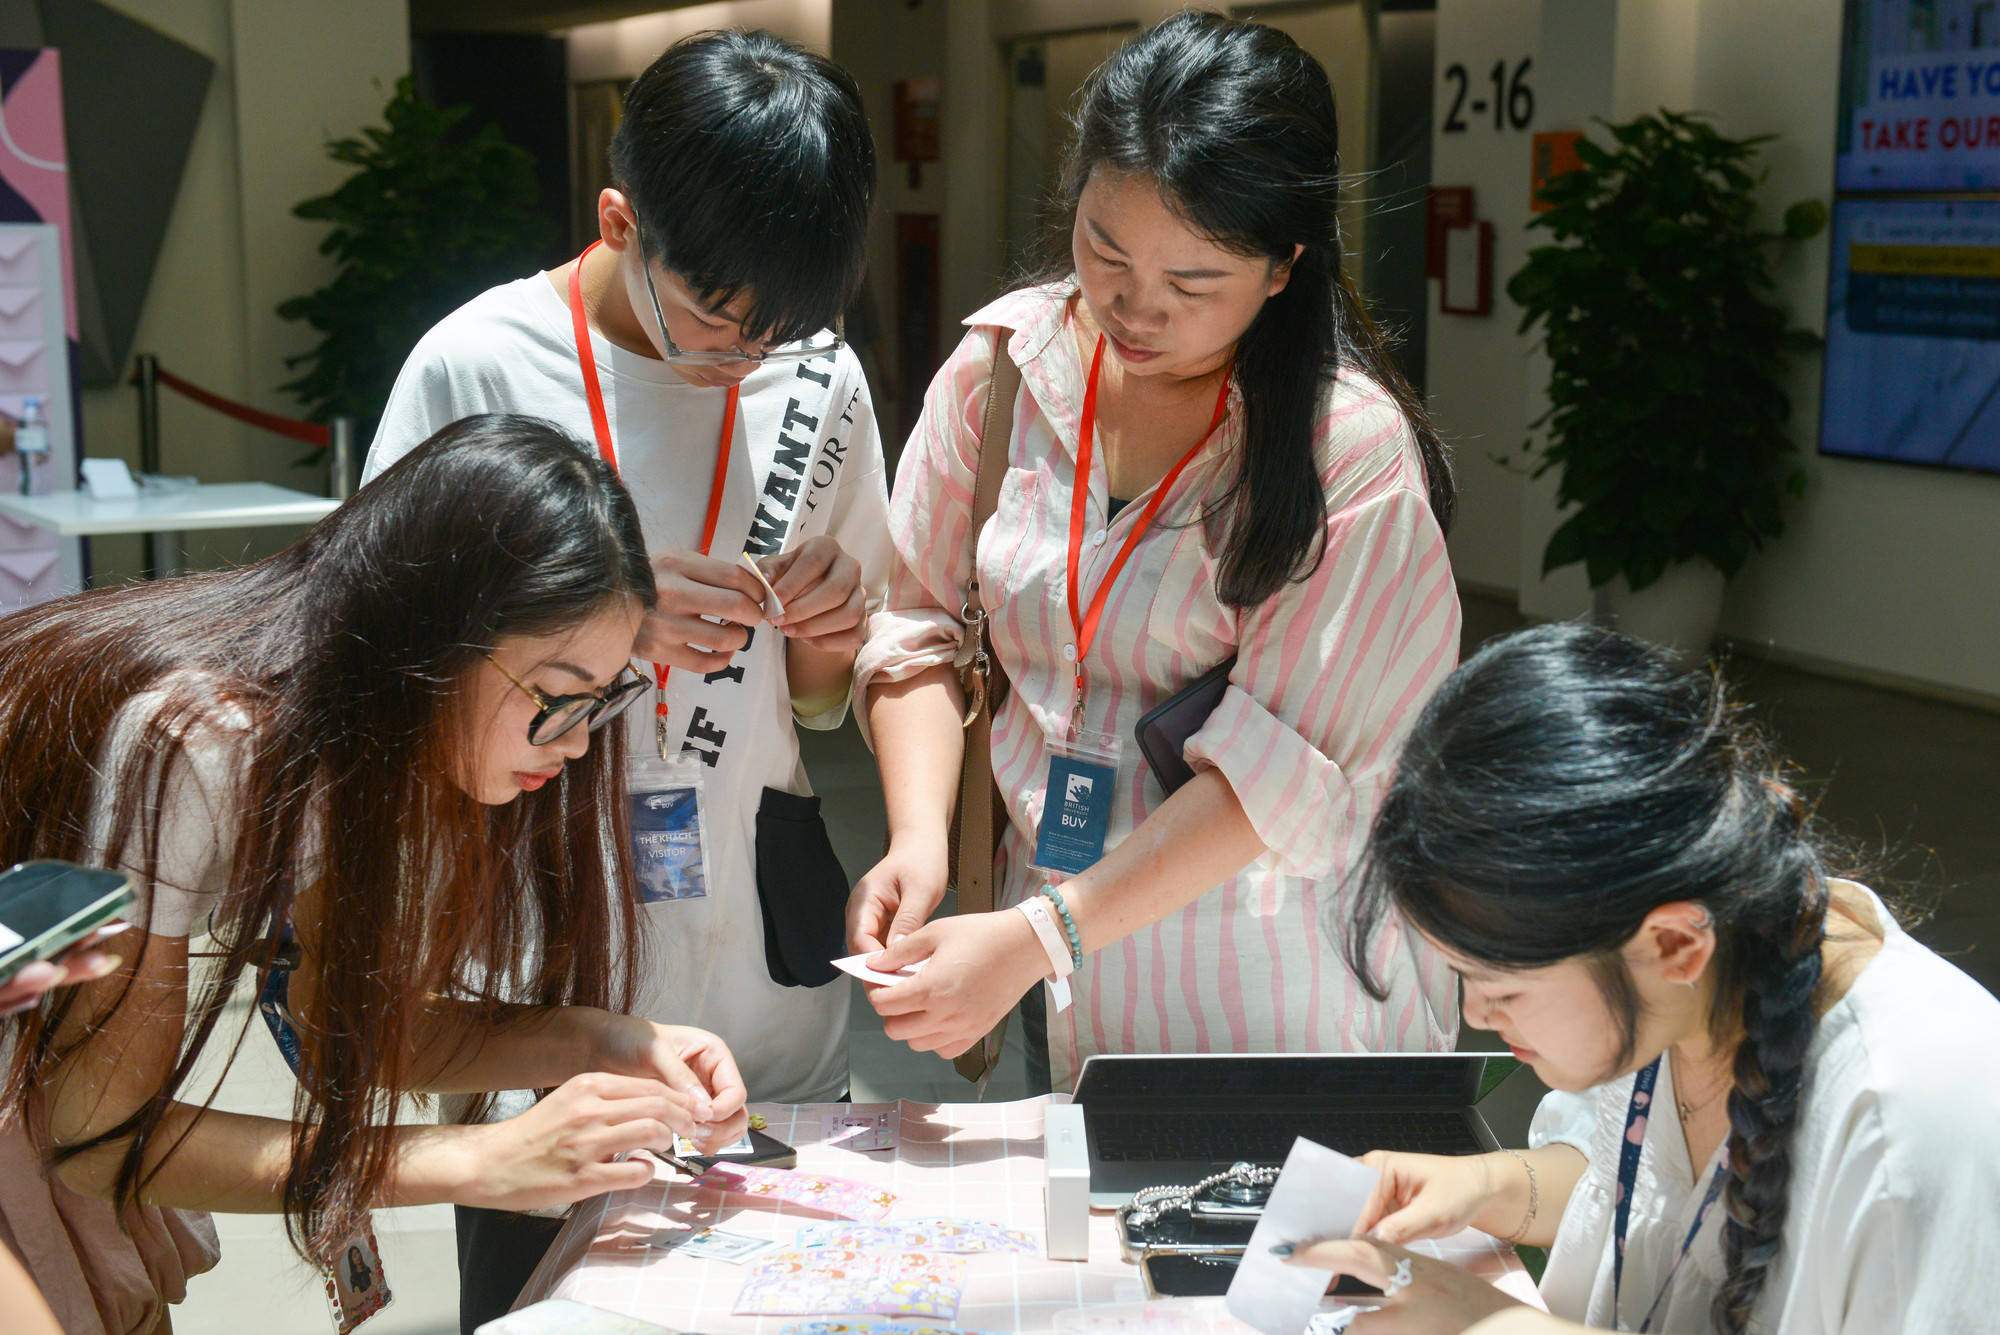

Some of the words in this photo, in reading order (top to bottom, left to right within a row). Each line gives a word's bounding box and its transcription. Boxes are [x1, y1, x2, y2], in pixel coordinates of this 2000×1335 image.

[1879, 64, 1958, 99] HAVE
[1443, 58, 1535, 132] 2-16
[1861, 119, 1930, 151] TAKE
[1939, 115, 2000, 150] OUR
[681, 706, 727, 768] IF
[743, 397, 819, 556] WANT
[1063, 807, 1088, 816] UNIVERSITY
[1064, 801, 1089, 812] BRITISH
[1062, 814, 1086, 828] BUV
[648, 847, 687, 859] VISITOR
